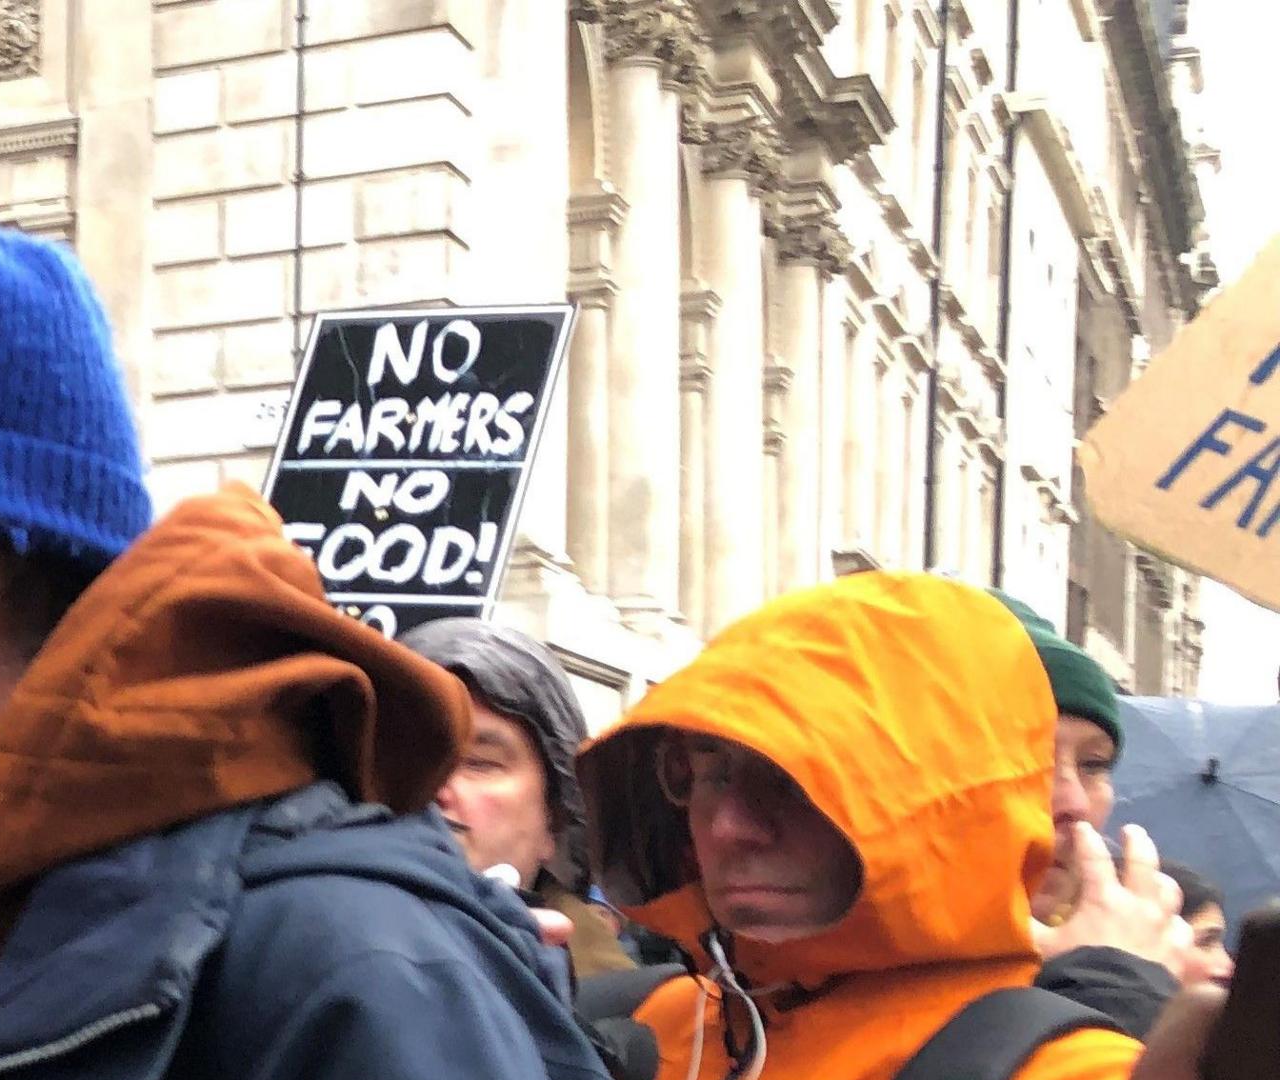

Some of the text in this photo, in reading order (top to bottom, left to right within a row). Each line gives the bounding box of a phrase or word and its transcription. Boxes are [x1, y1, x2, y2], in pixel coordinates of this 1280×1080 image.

[367, 319, 482, 388] NO
[297, 391, 535, 457] FARMERS
[339, 470, 450, 515] NO
[1155, 406, 1280, 538] FA
